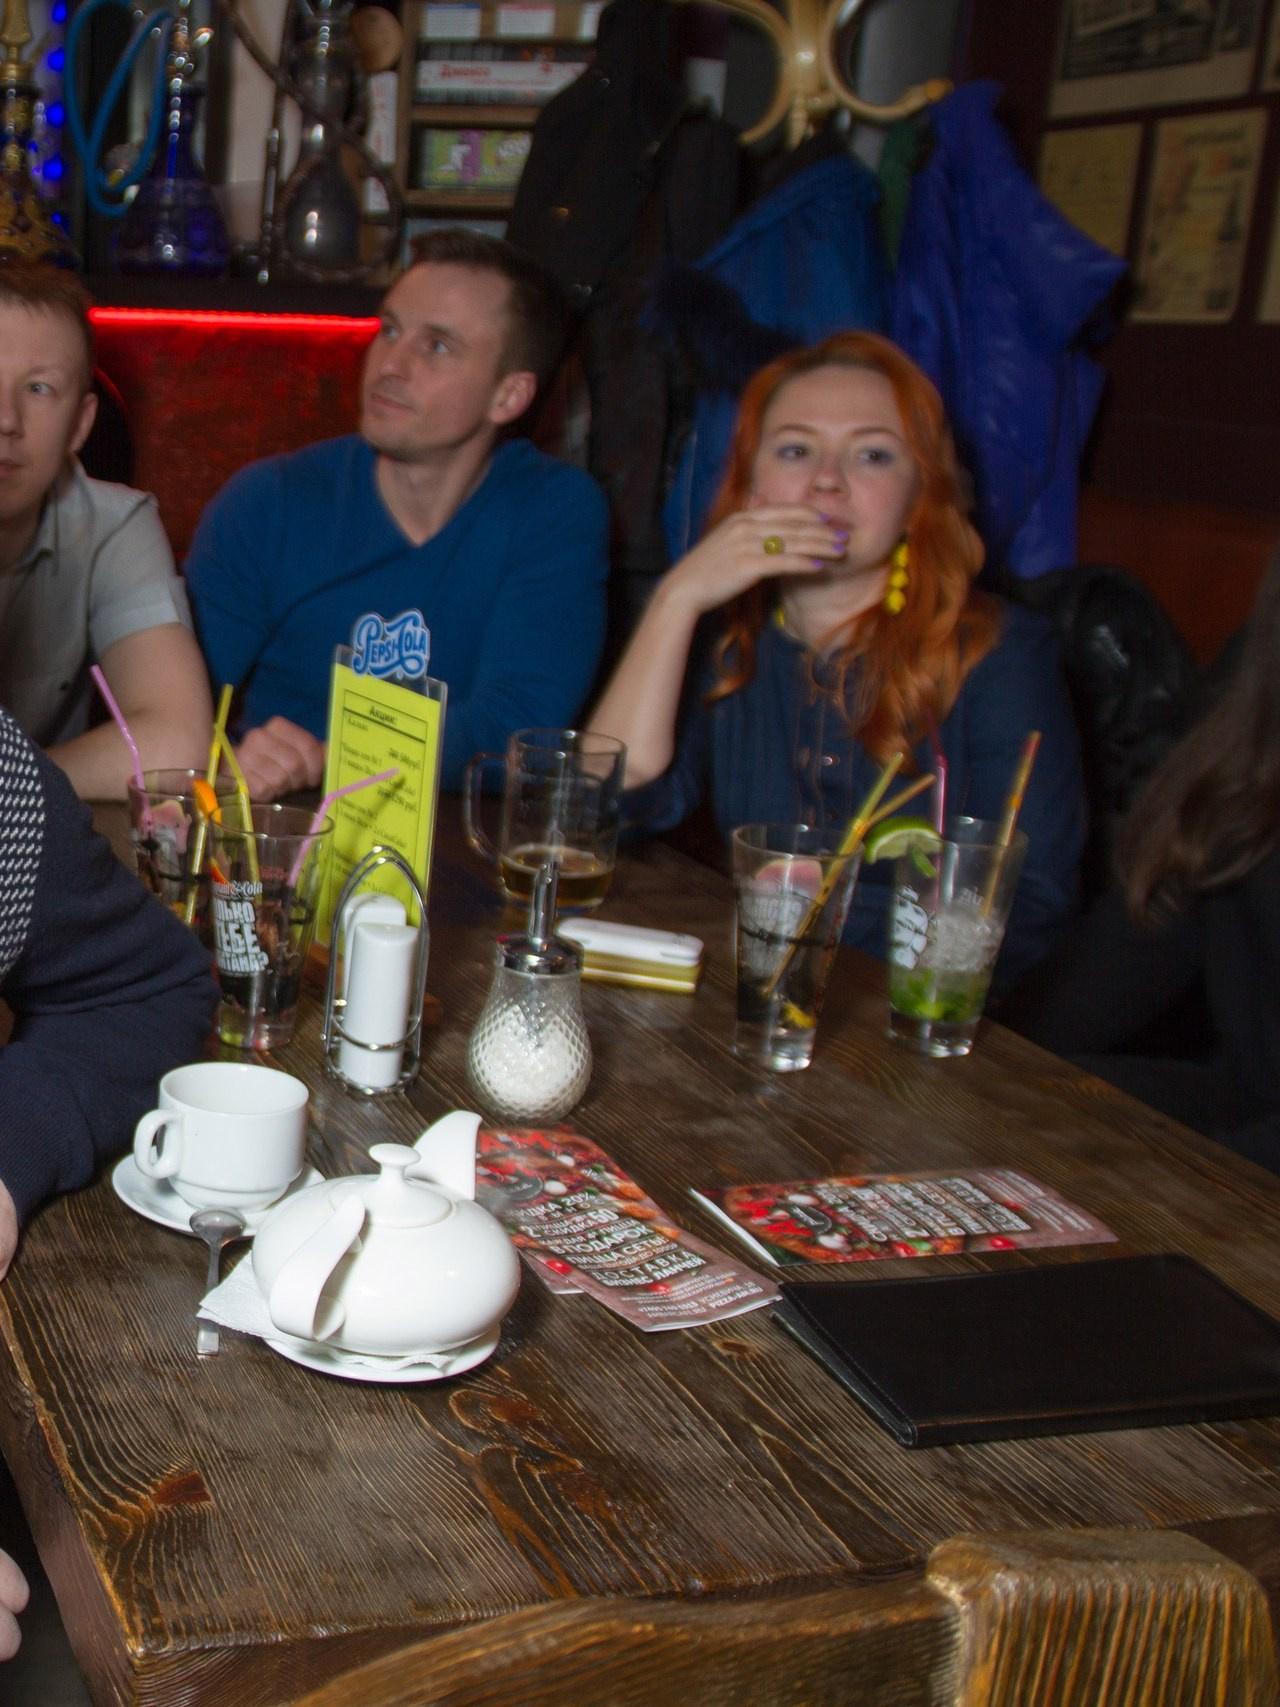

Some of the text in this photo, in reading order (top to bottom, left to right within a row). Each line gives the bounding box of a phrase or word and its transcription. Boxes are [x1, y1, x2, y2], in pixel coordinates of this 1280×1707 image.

[243, 880, 263, 897] Cola
[507, 1202, 563, 1218] КИДКА
[561, 1192, 596, 1207] 20%
[544, 1219, 597, 1237] СКИДКА
[599, 1219, 639, 1235] ПИЦЦА
[549, 1225, 655, 1254] В ПОДАРОК
[566, 1251, 625, 1265] ПИЦЦА
[591, 1250, 697, 1280] ДОСТАВКА
[602, 1255, 707, 1287] БИЗНЕС ЛАНЧЕЙ
